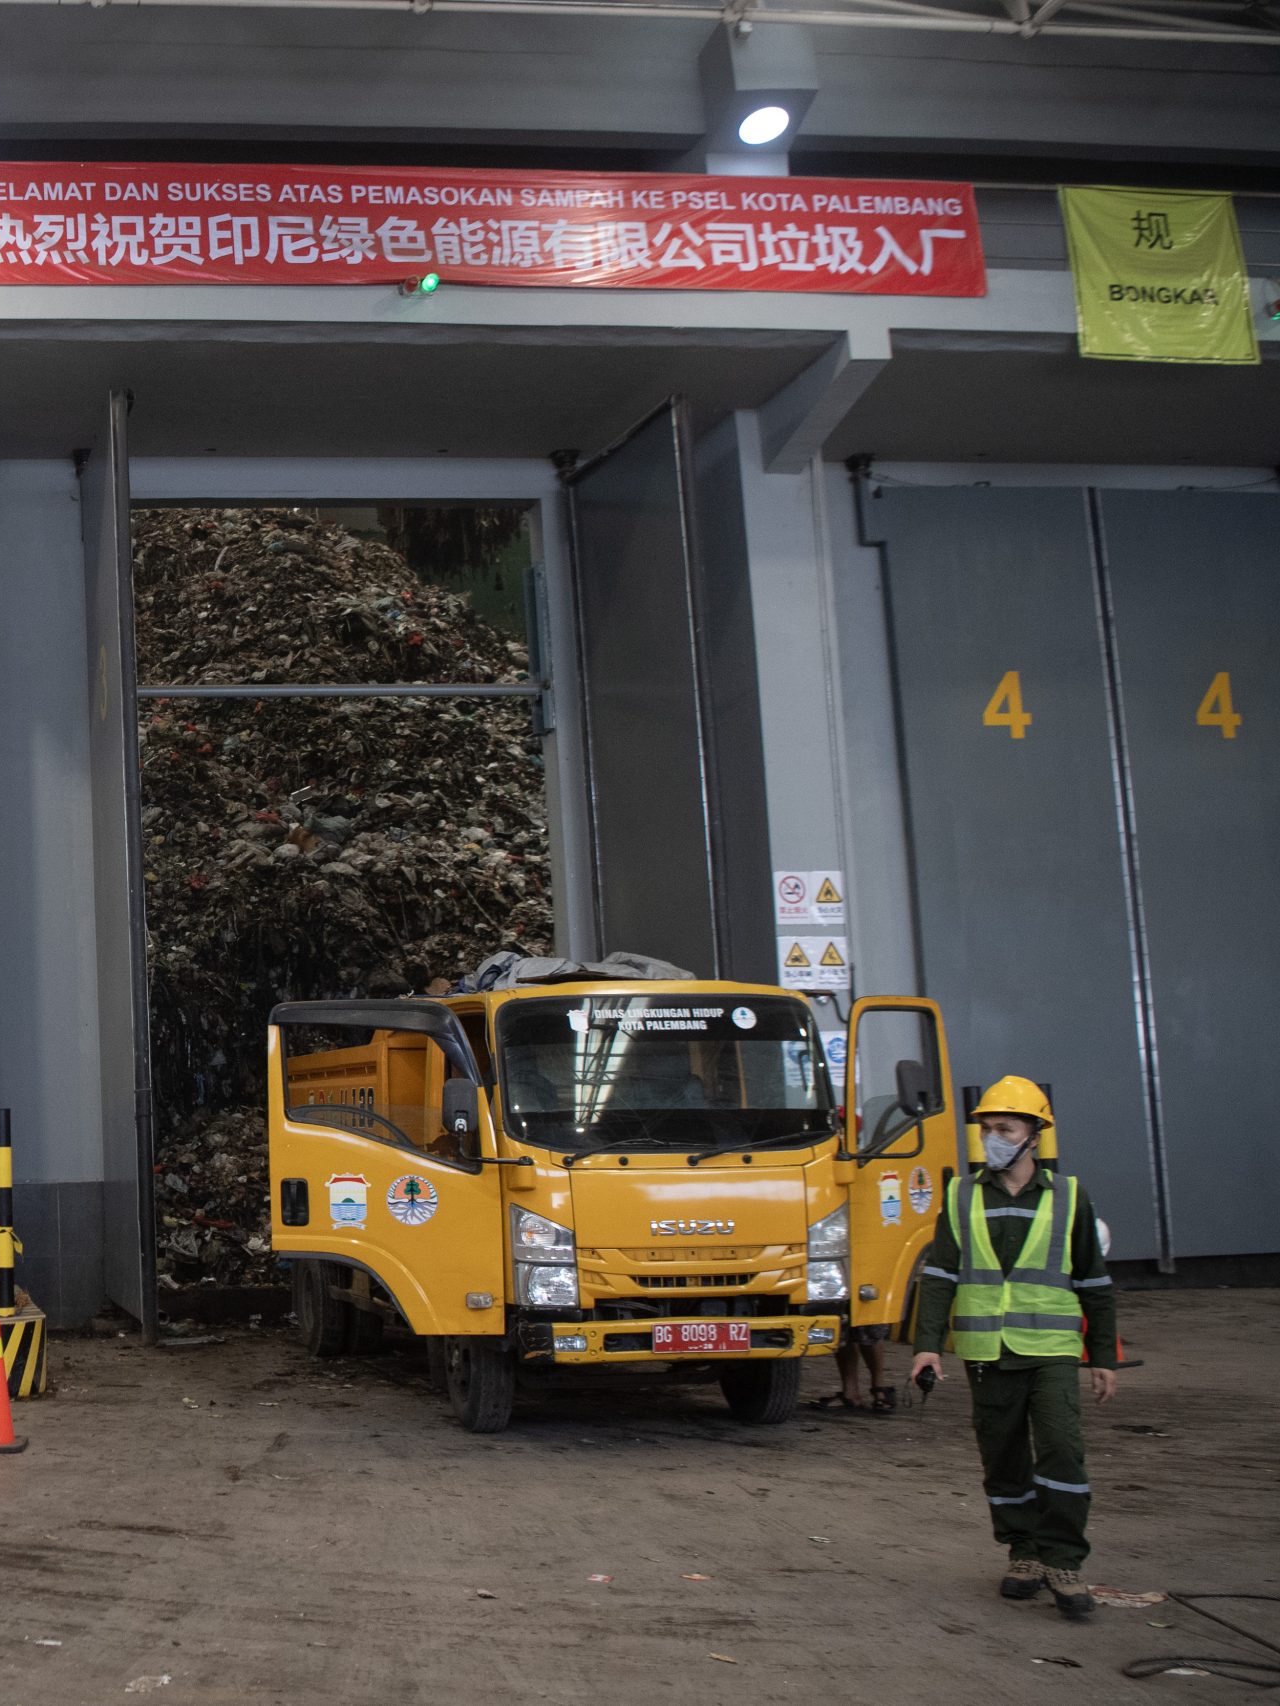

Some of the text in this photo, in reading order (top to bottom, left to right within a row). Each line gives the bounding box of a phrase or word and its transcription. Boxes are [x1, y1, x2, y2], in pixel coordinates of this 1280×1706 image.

[104, 182, 158, 202] DAN
[167, 182, 272, 203] SUKSES
[278, 183, 343, 204] ATAS
[351, 184, 512, 207] PEMASOKAN
[519, 187, 625, 209] SAMPAH
[631, 190, 665, 210] KE
[671, 190, 736, 211] PSEL
[741, 192, 808, 212] KOTA
[812, 194, 964, 217] PALEMBANG
[1108, 283, 1220, 307] BONGKAR
[982, 670, 1033, 739] 4
[1195, 671, 1242, 739] 4
[594, 1007, 725, 1019] DINAS LINGKUNGAN HIDUP
[617, 1019, 708, 1031] KOTA PALEMBANG
[650, 1219, 736, 1236] ISUZU
[654, 1323, 749, 1343] BG 8098 RZ
